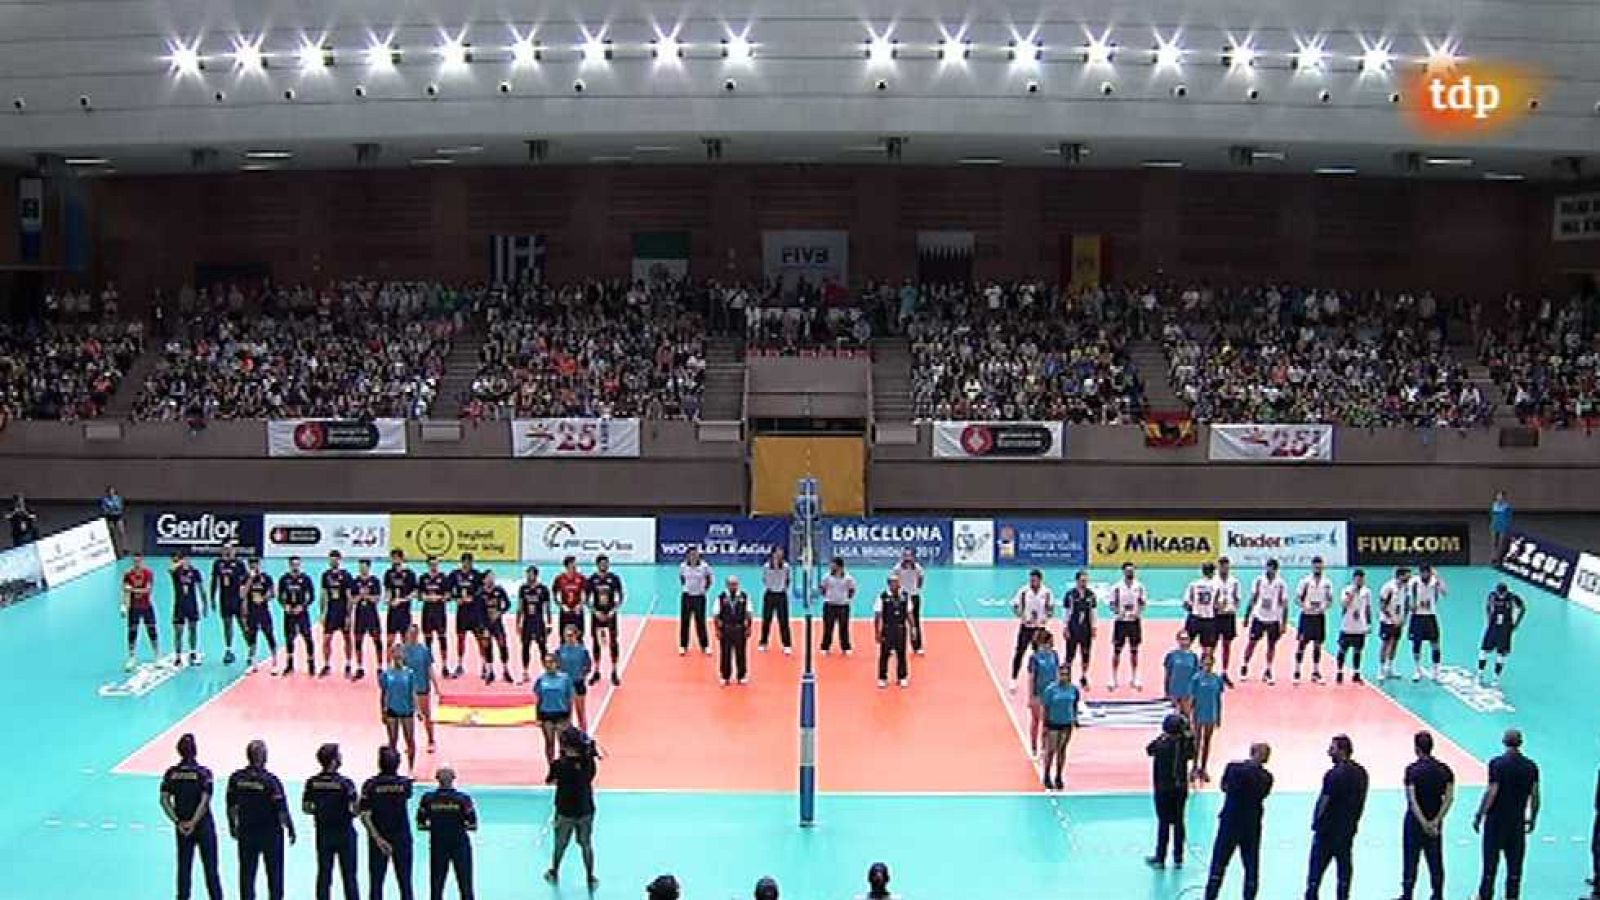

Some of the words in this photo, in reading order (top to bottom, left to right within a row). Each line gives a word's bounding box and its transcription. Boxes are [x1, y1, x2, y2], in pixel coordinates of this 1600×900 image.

[783, 247, 829, 264] FIVB
[556, 422, 597, 452] 25
[157, 513, 239, 542] Gerflor
[831, 524, 942, 542] BARCELONA
[720, 543, 775, 554] LEAGU
